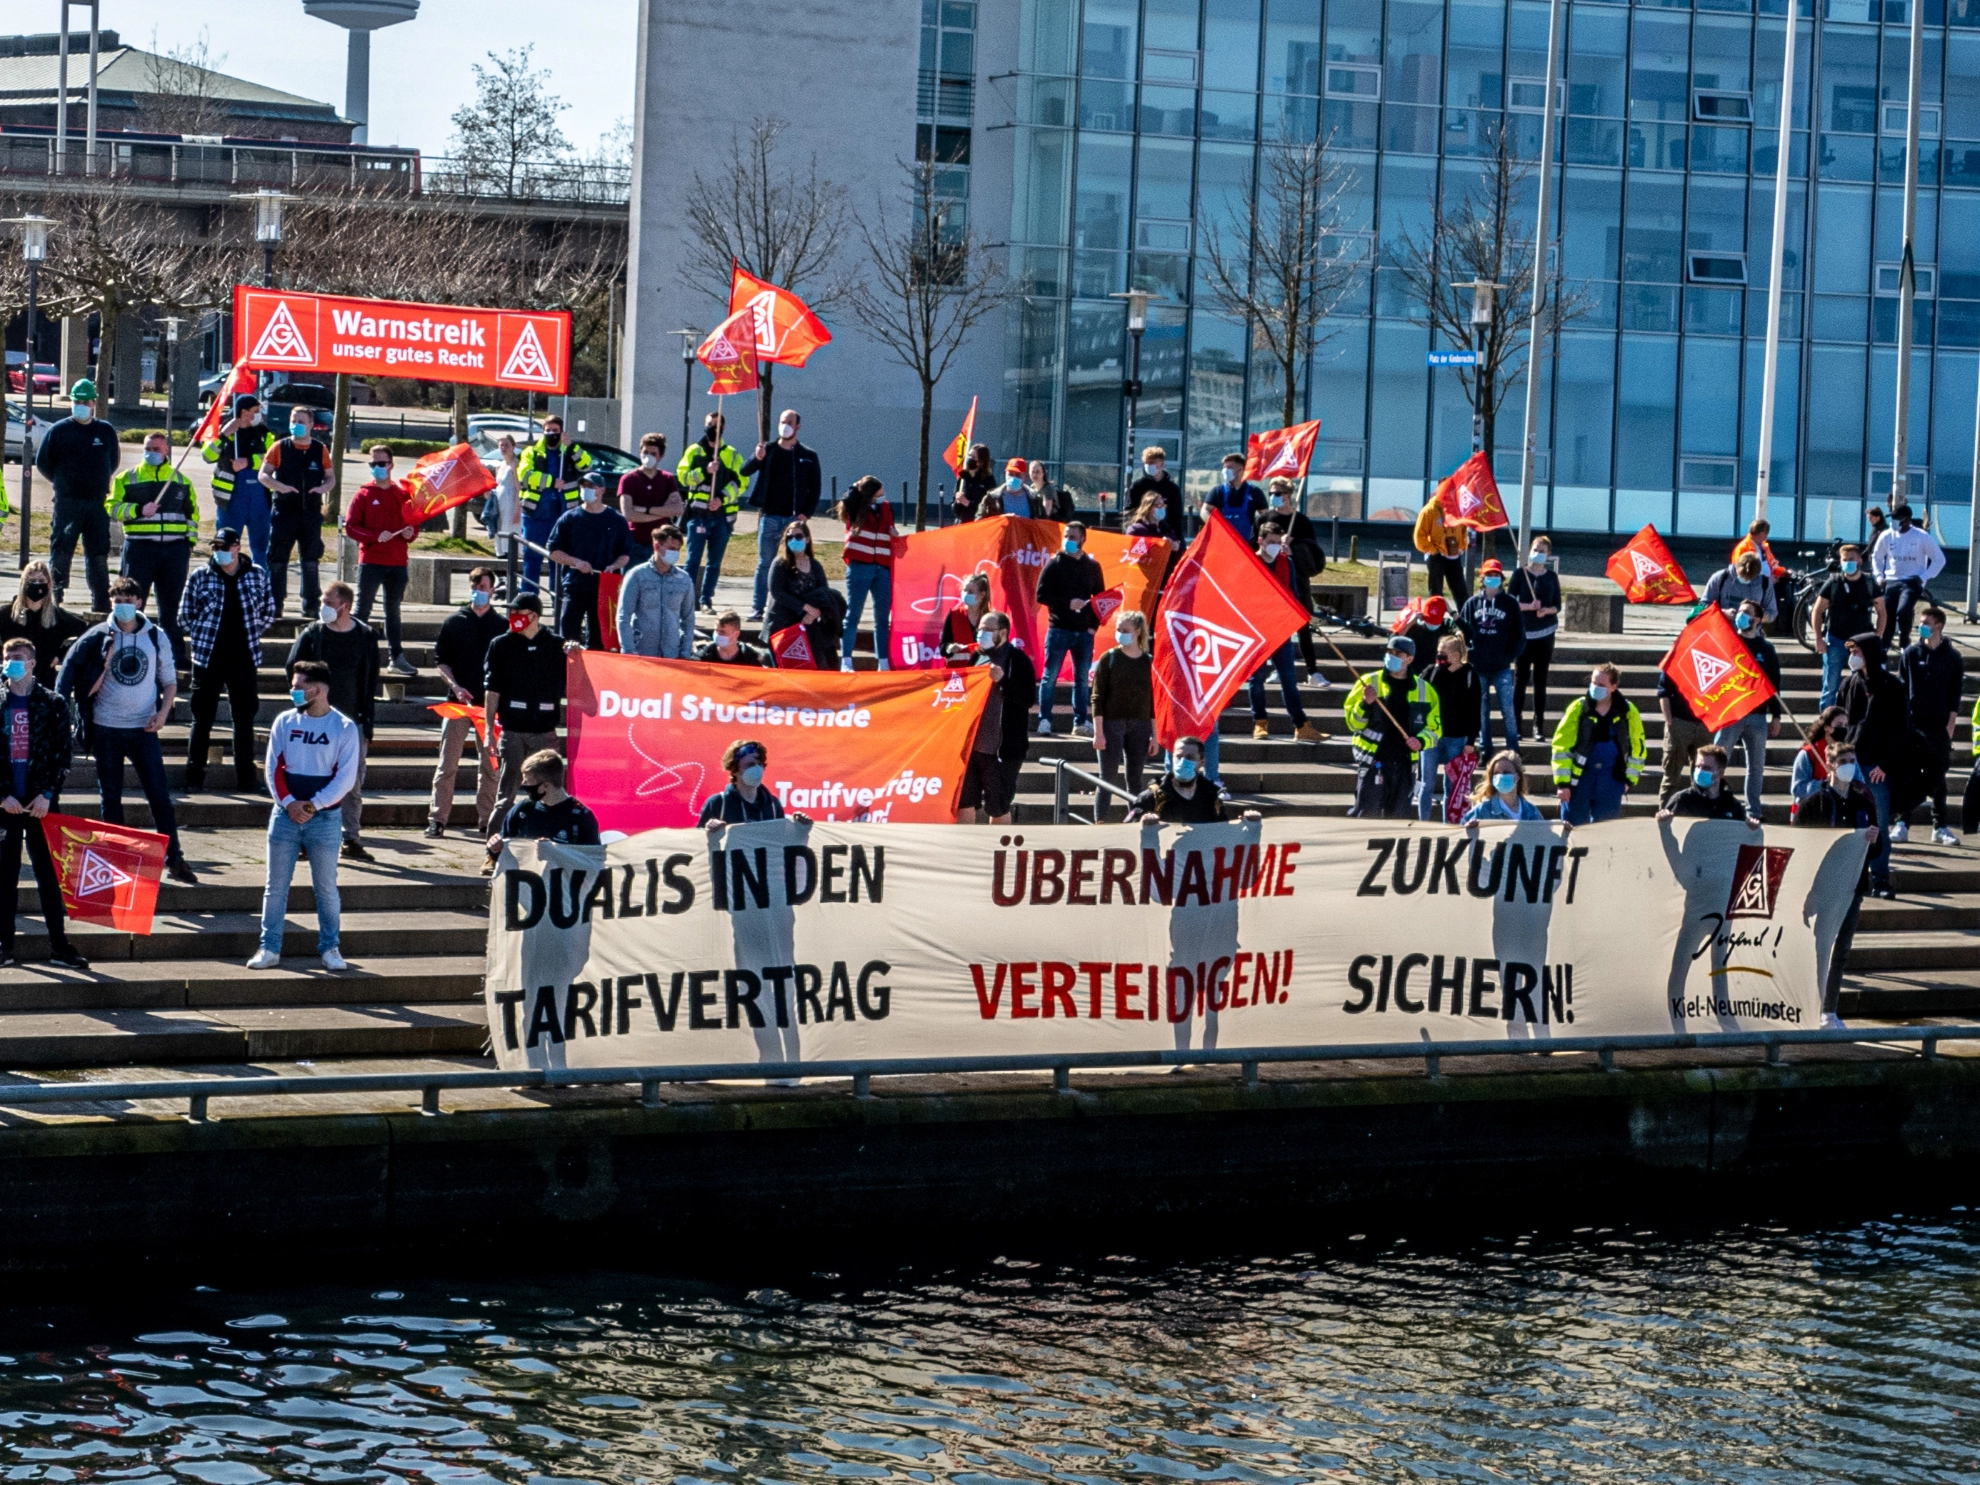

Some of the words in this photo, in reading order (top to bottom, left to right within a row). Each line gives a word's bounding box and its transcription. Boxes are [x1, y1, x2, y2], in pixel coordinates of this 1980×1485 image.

[332, 309, 486, 347] Warnstreik
[332, 343, 384, 360] unser
[385, 347, 434, 364] gutes
[437, 348, 485, 368] Recht
[289, 729, 330, 745] FILA
[599, 690, 672, 719] Dual
[680, 695, 871, 728] Studierende
[505, 853, 696, 931] DUALIS
[711, 847, 770, 911] IN
[783, 844, 885, 906] DEN
[991, 835, 1302, 907] ÜBERNAHME
[1356, 836, 1590, 906] ZUKUNFT
[494, 959, 892, 1051] TARIFVERTRAG
[968, 949, 1294, 1024] VERTEIDIGEN!
[1341, 953, 1576, 1025] SICHERN!
[1672, 995, 1803, 1023] Kiel-Neumünster
